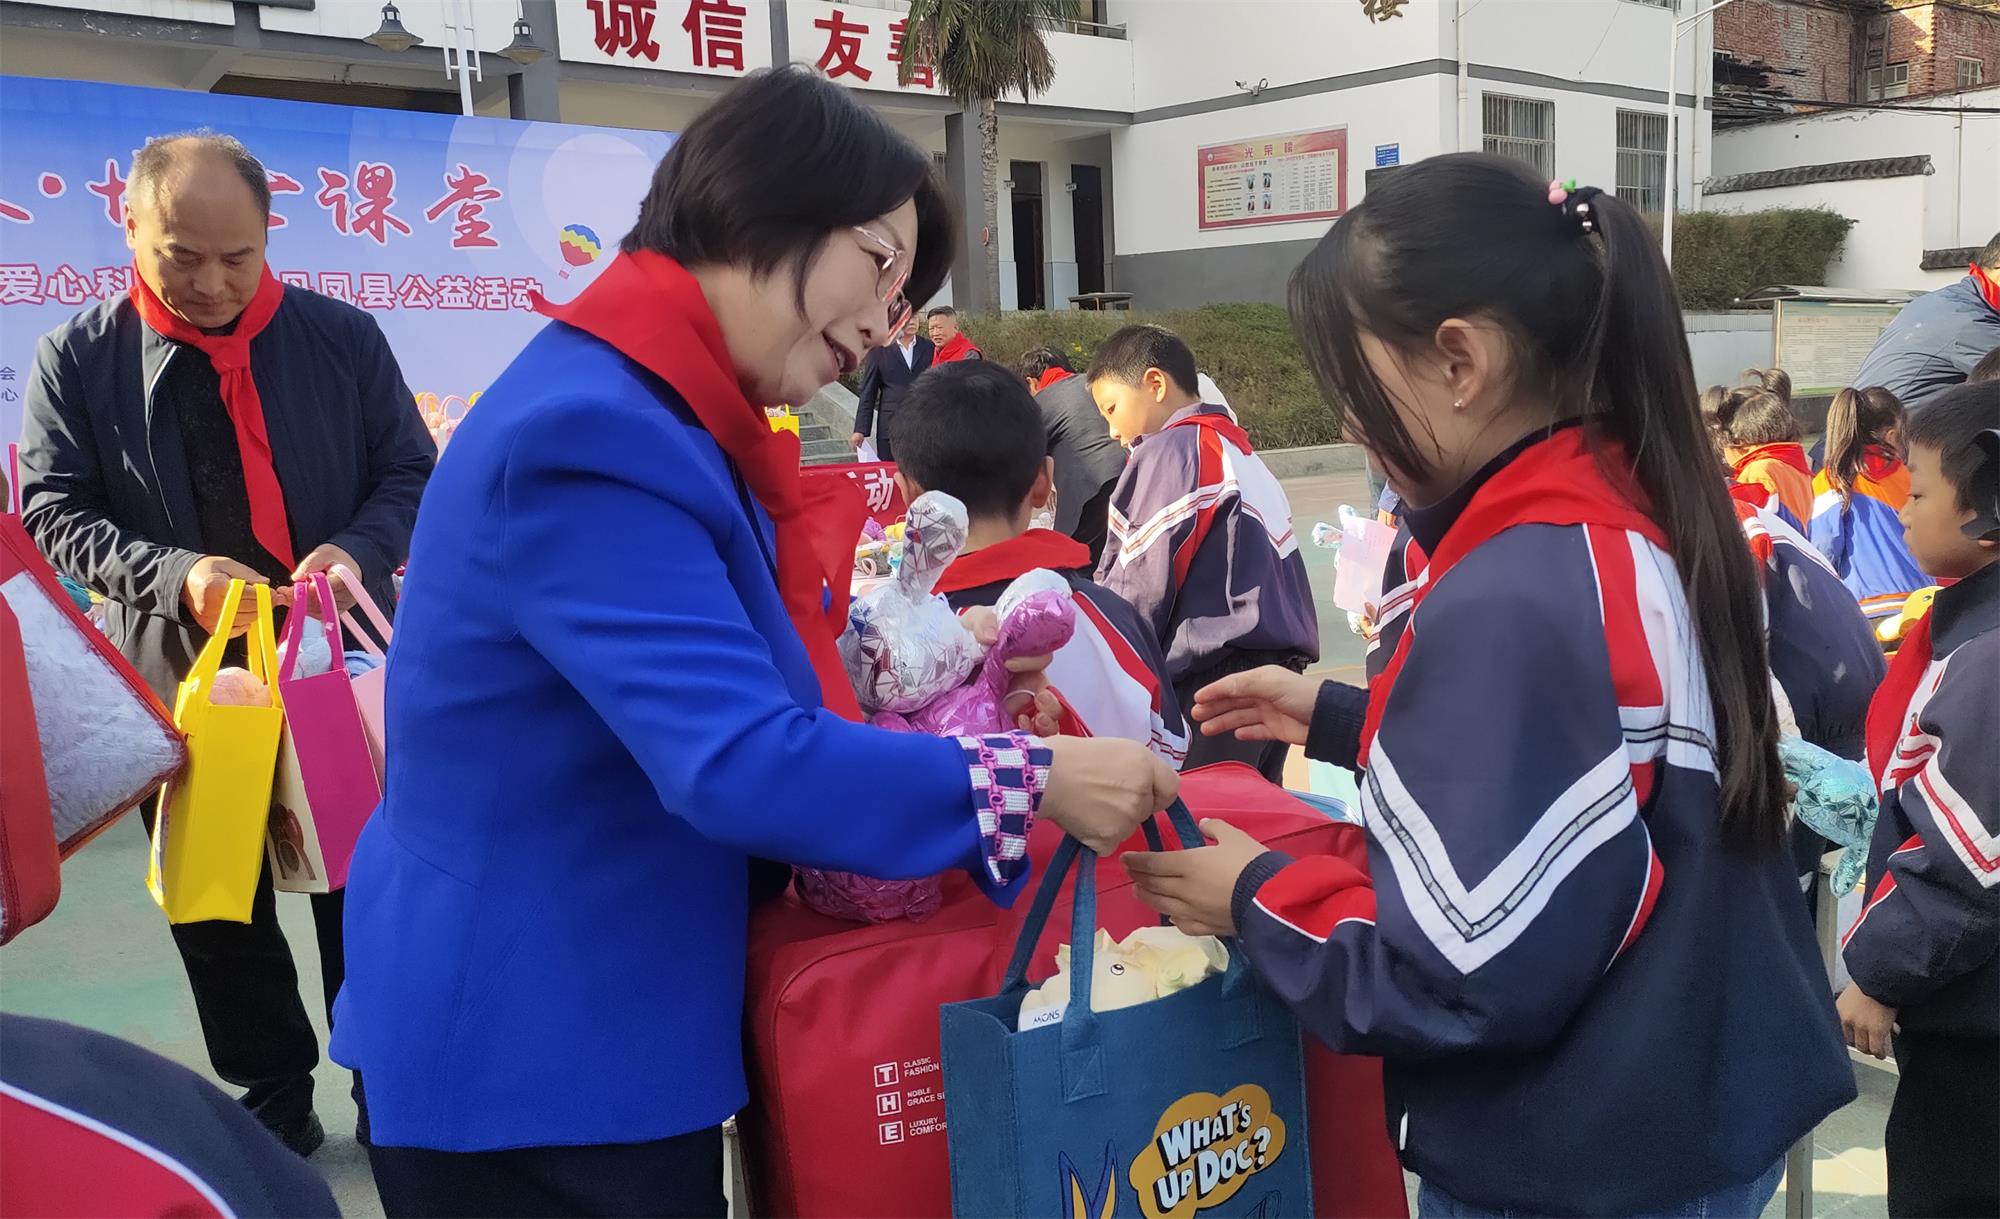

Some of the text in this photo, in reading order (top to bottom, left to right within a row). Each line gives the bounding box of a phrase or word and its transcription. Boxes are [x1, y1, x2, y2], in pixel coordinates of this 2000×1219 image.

[586, 0, 747, 71] 诚信
[847, 468, 895, 513] 动
[904, 1056, 931, 1069] CLASSIC
[904, 1063, 939, 1077] FASHION
[907, 1087, 931, 1098] NOBLE
[907, 1094, 935, 1107] GRACE
[909, 1116, 938, 1128] LUXURY
